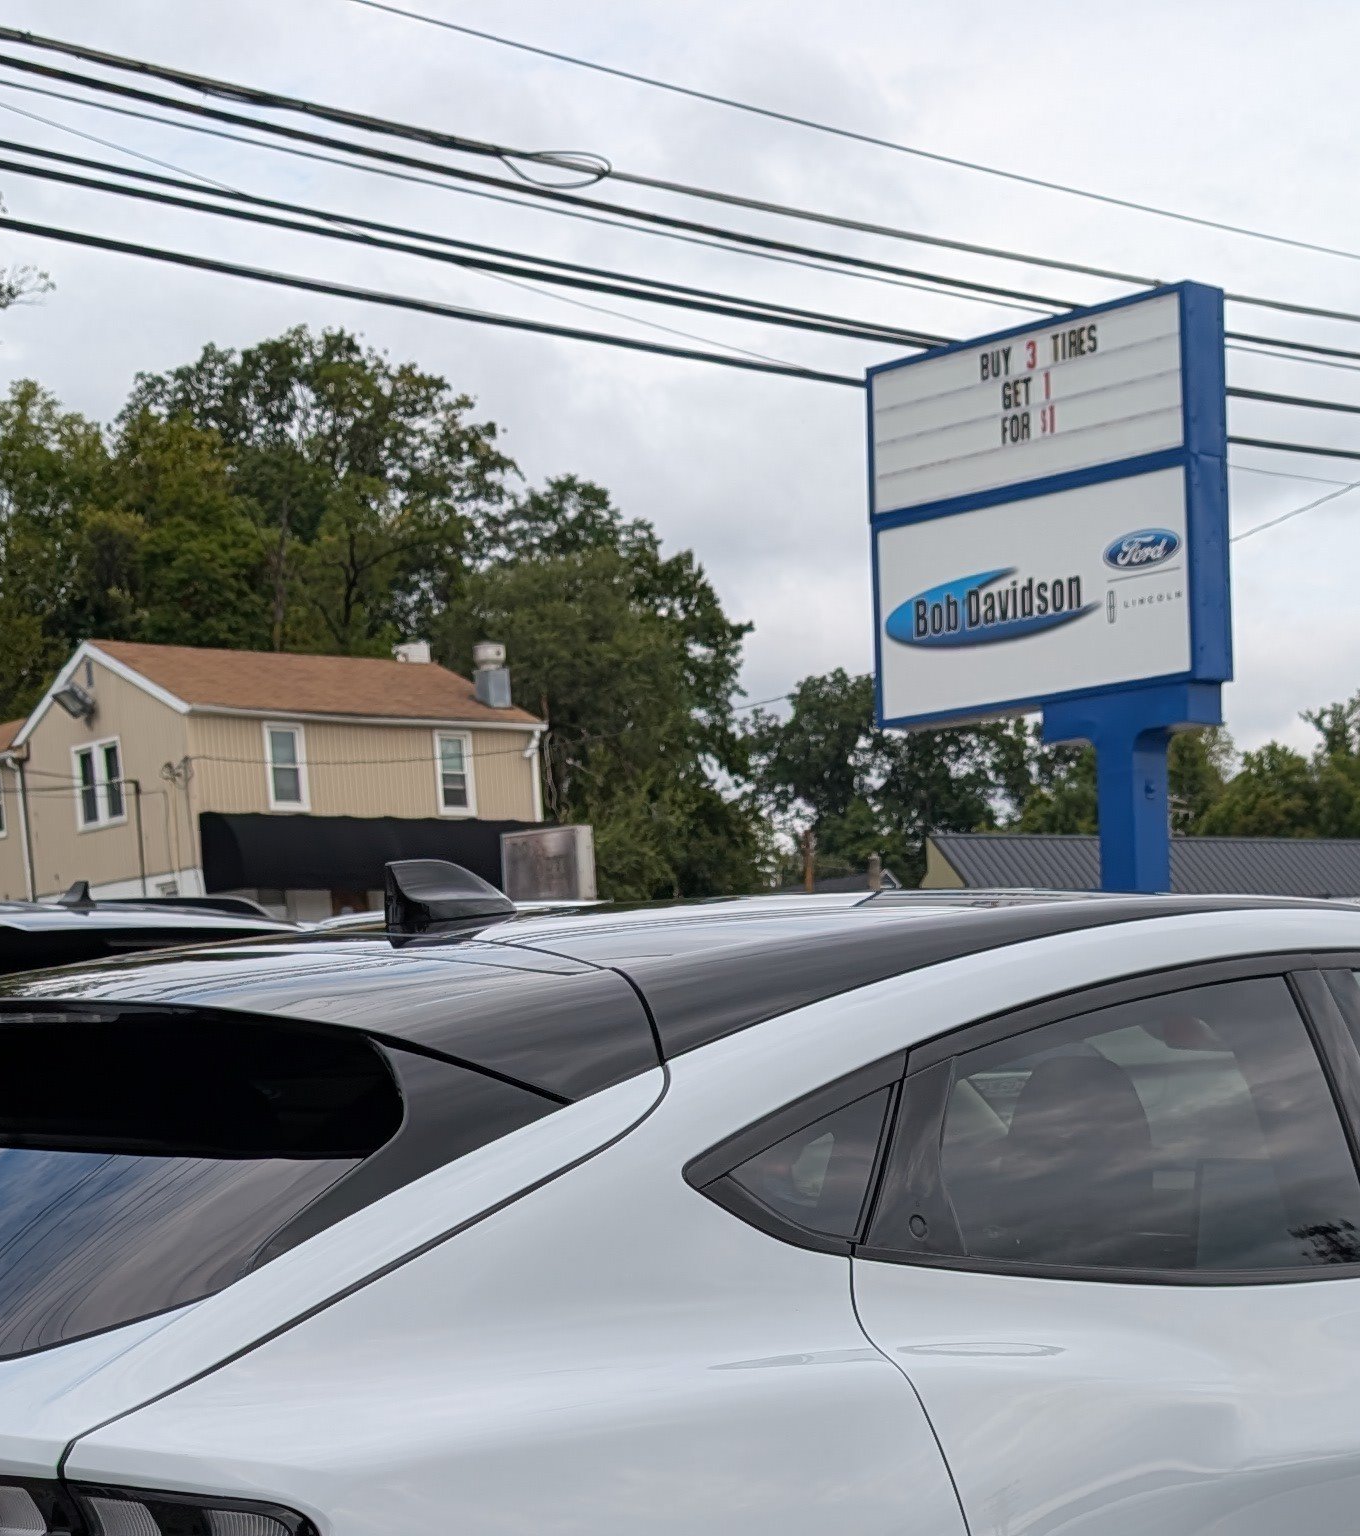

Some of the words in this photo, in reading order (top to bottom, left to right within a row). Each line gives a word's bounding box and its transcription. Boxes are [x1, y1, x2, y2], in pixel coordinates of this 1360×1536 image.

[980, 346, 1011, 381] BUY
[1025, 340, 1038, 370] 3
[1050, 324, 1098, 362] TIRES
[1001, 376, 1032, 410] GET
[1043, 370, 1051, 400] 1
[1001, 411, 1031, 445] FOR
[1115, 532, 1171, 568] Ford
[914, 593, 960, 639] Bob
[966, 574, 1082, 630] Davidson
[1123, 589, 1183, 609] LINCOLN
